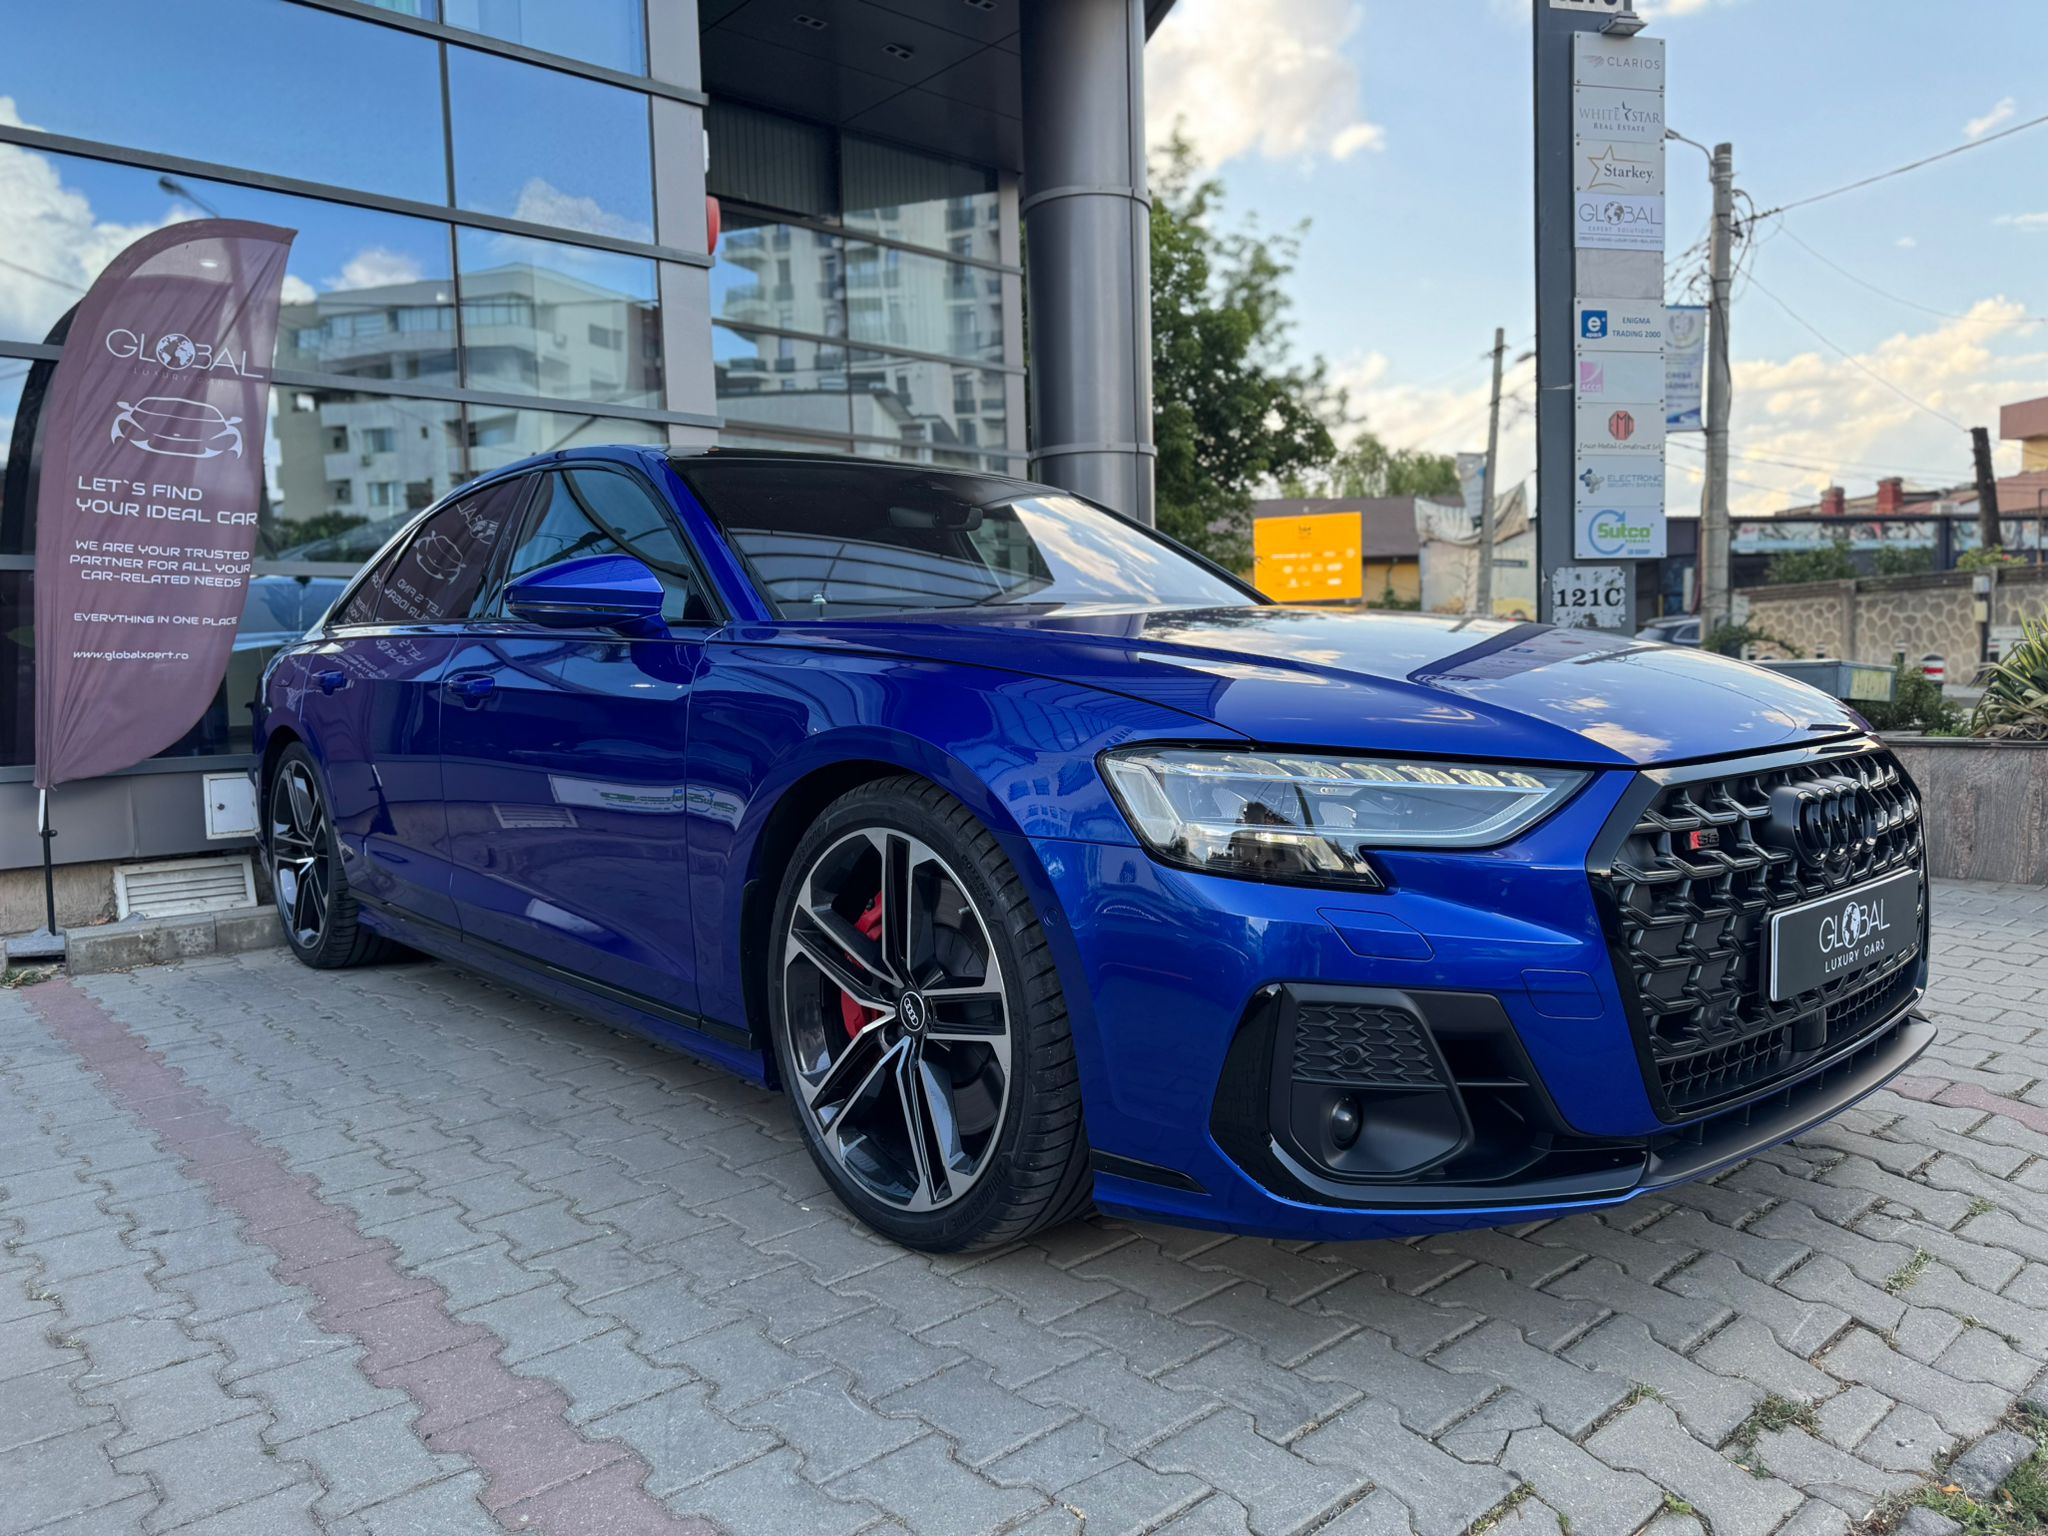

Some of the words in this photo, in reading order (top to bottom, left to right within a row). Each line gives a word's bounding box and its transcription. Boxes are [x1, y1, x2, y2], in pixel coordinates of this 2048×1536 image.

[1607, 56, 1661, 70] CLARIOS
[1579, 107, 1620, 121] WHITE
[1632, 110, 1662, 124] STAR
[1578, 200, 1663, 226] GLOBAL
[1622, 316, 1651, 325] ENIGMA
[1612, 329, 1643, 338] TRADING
[1644, 330, 1662, 338] 2000
[105, 328, 264, 380] GLOBAL
[152, 483, 203, 501] FIND
[75, 497, 140, 518] YOUR
[146, 504, 211, 523] IDEAL
[75, 540, 98, 551] WE
[102, 541, 134, 554] ARE
[138, 544, 181, 557] YOUR
[184, 547, 250, 561] TRUSTED
[69, 554, 144, 569] PARTNER
[147, 559, 179, 571] FOR
[182, 561, 212, 573] ALL
[214, 562, 251, 575] YOUR
[81, 569, 191, 585] CAR-RELATED
[194, 575, 242, 588] NEEDS
[1557, 587, 1621, 608] 121C
[73, 612, 155, 624] EVERYTHING
[157, 615, 169, 624] IN
[172, 615, 199, 625] ONE
[202, 615, 237, 626] PLACE
[73, 650, 189, 662] www.globalxpert.ro
[1818, 898, 1891, 954] GLOBAL
[1824, 951, 1860, 974] LUXURY
[1863, 938, 1886, 957] CARS
